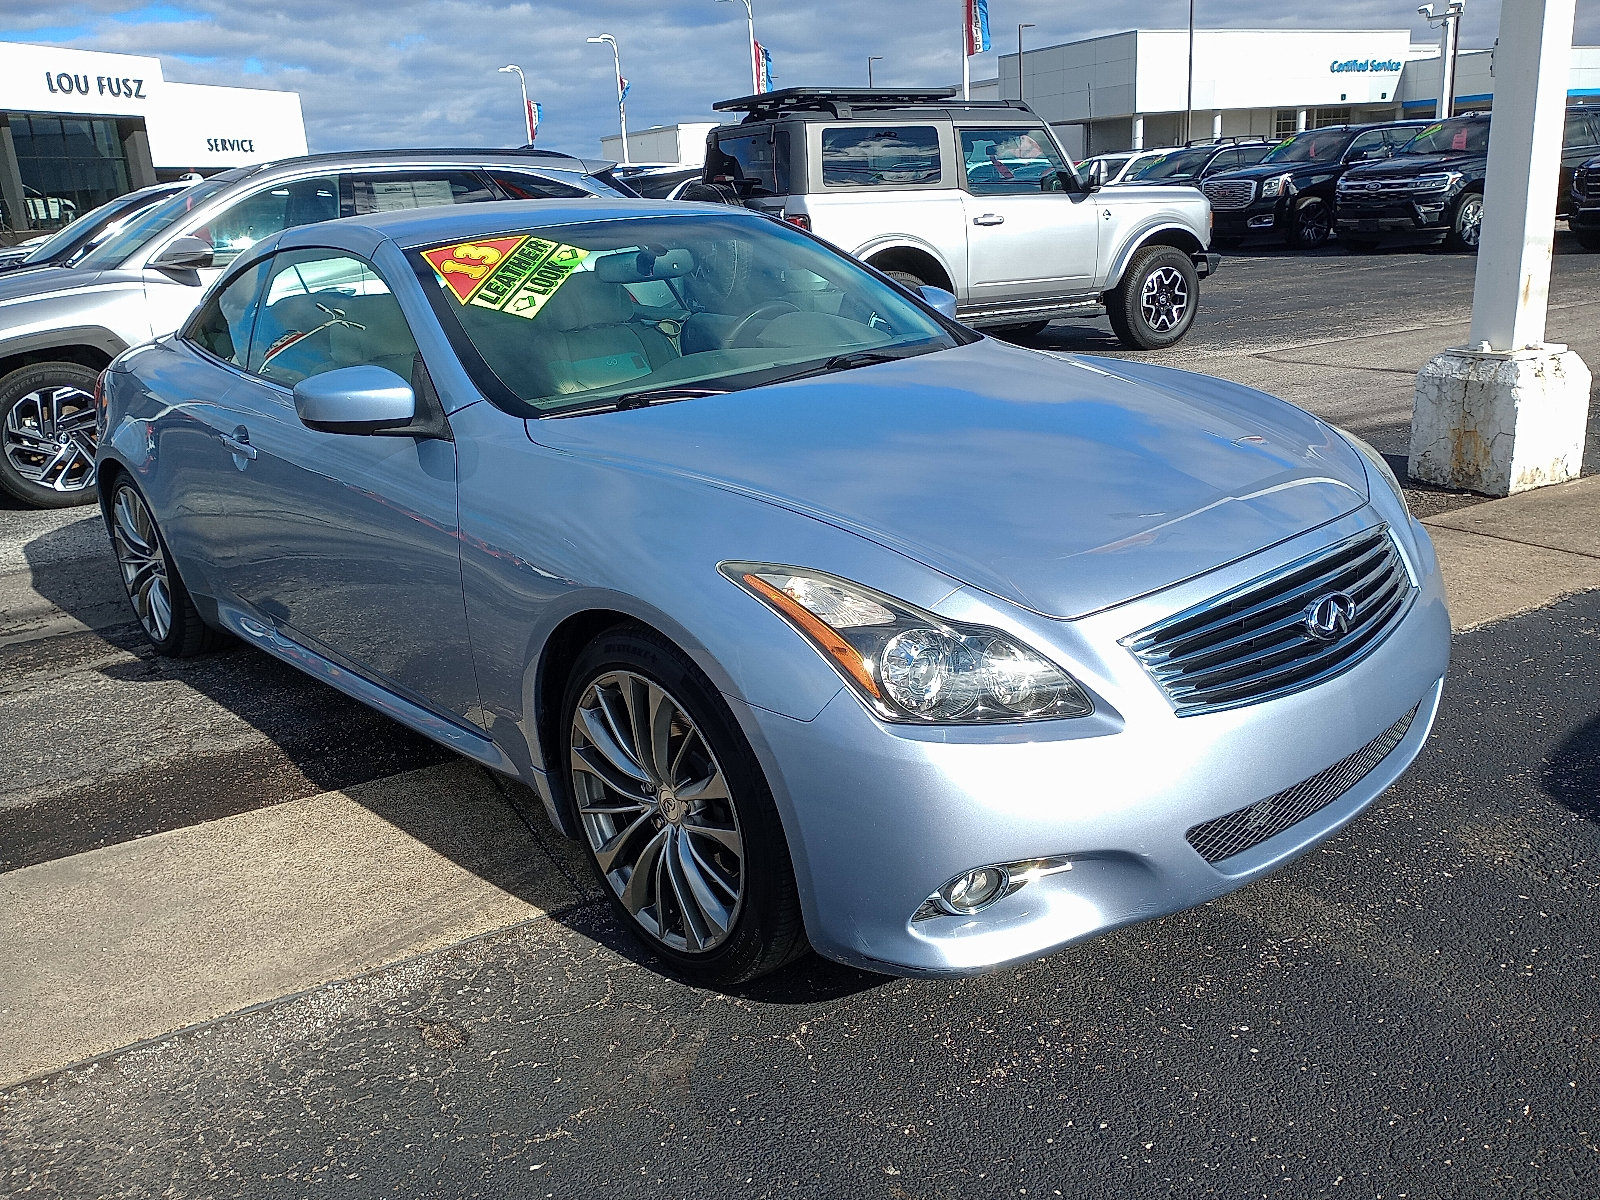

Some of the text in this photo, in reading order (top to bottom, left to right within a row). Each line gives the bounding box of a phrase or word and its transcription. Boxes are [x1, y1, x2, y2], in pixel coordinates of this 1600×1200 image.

[1330, 59, 1402, 73] Certified Service
[46, 72, 147, 99] LOU FUSZ
[206, 138, 255, 153] SERVICE
[441, 244, 502, 280] 13
[477, 240, 553, 305] LEATHER
[523, 260, 574, 296] LOOK
